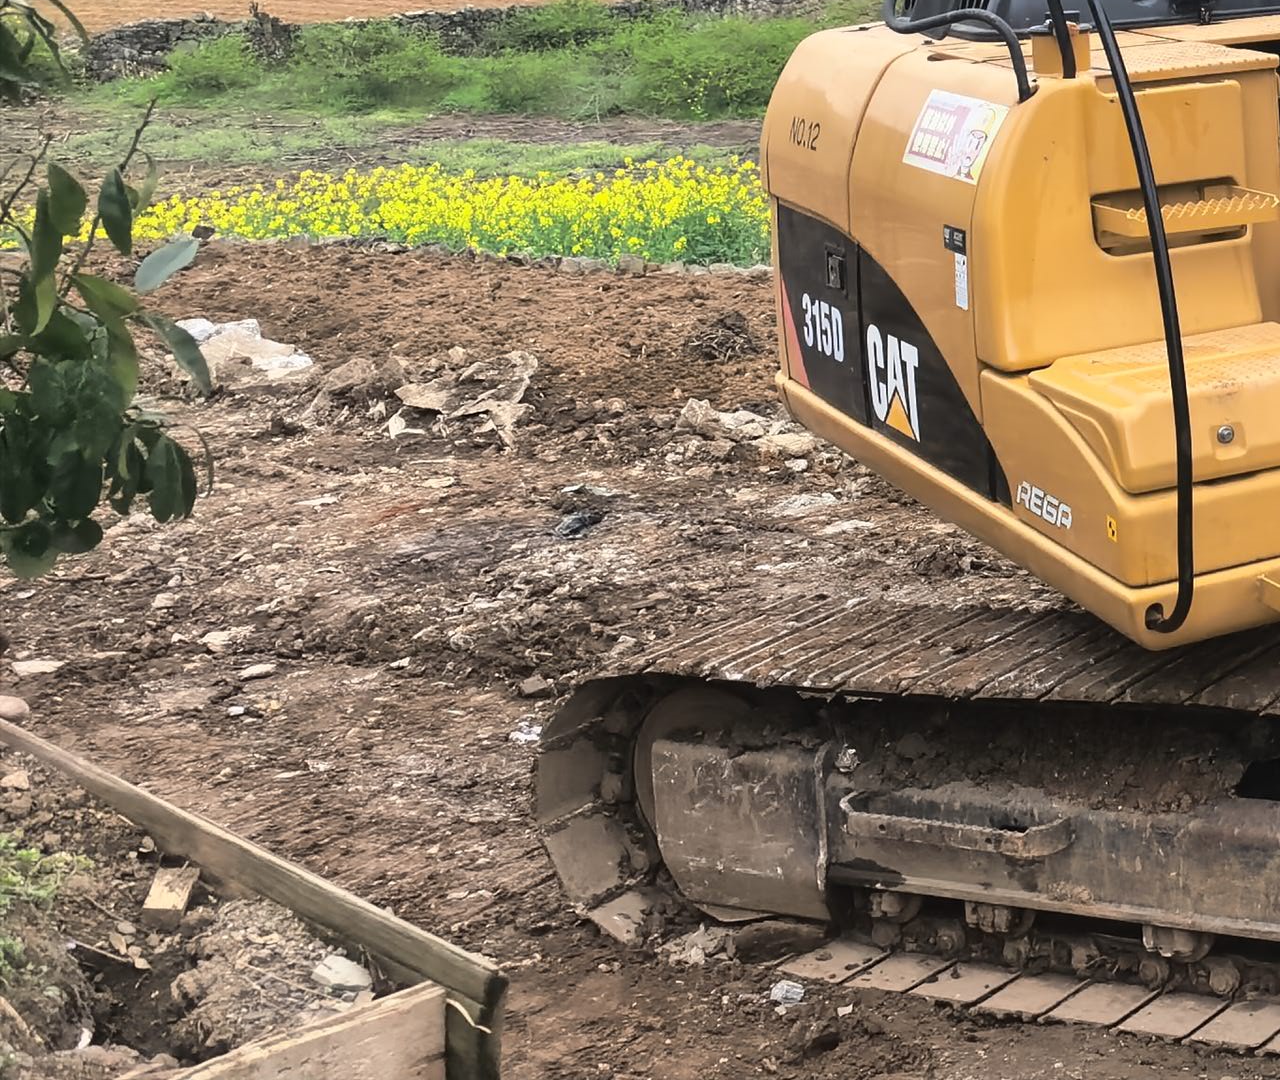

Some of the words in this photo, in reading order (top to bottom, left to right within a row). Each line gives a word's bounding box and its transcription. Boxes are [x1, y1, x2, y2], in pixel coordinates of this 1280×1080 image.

[789, 116, 821, 152] NO.12
[802, 293, 845, 363] 315D
[866, 323, 921, 443] CAT
